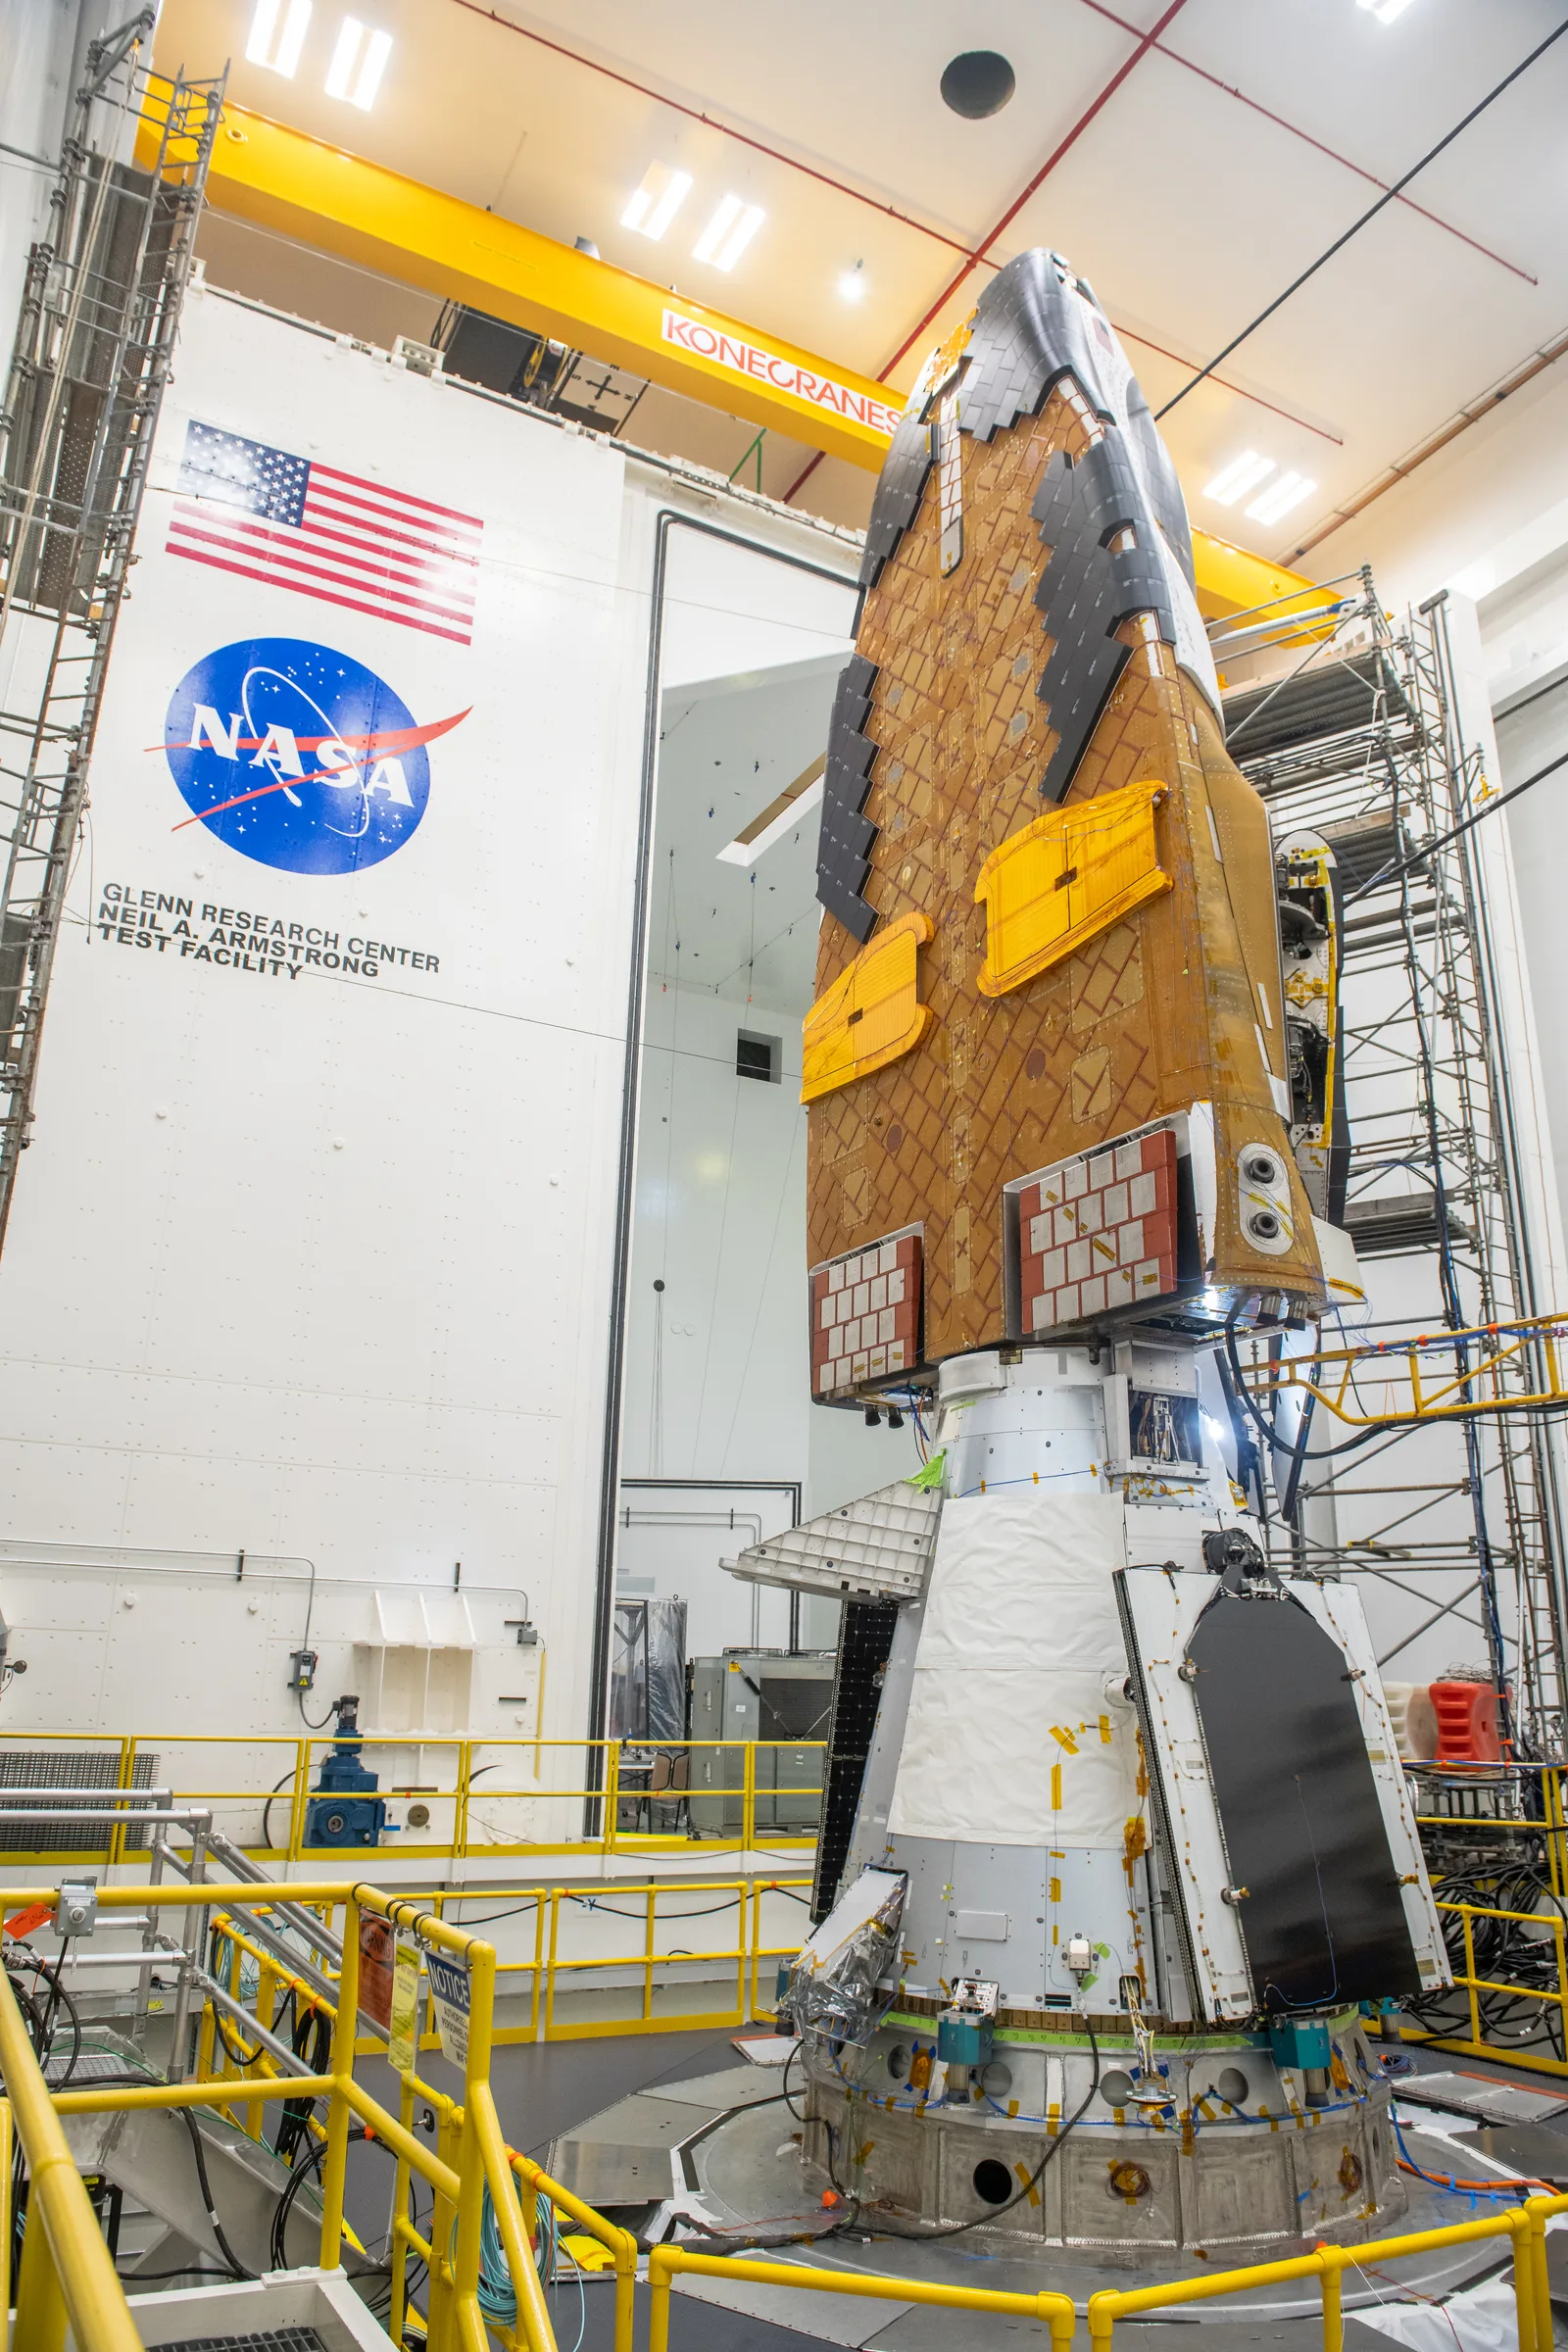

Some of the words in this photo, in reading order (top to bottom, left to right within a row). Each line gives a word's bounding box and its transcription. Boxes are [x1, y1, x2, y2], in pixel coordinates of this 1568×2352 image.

[666, 314, 903, 436] KONECRANES
[186, 702, 415, 808] NASA
[98, 902, 164, 932] NEIL
[172, 920, 199, 940] A.
[208, 928, 379, 978] ARMSTRONG
[98, 923, 172, 954] TEST
[179, 940, 304, 981] FACILITY
[103, 882, 193, 918] GLENN
[202, 904, 340, 951] RESEARCH
[347, 938, 440, 973] CENTER
[428, 1960, 470, 2008] NOTICE
